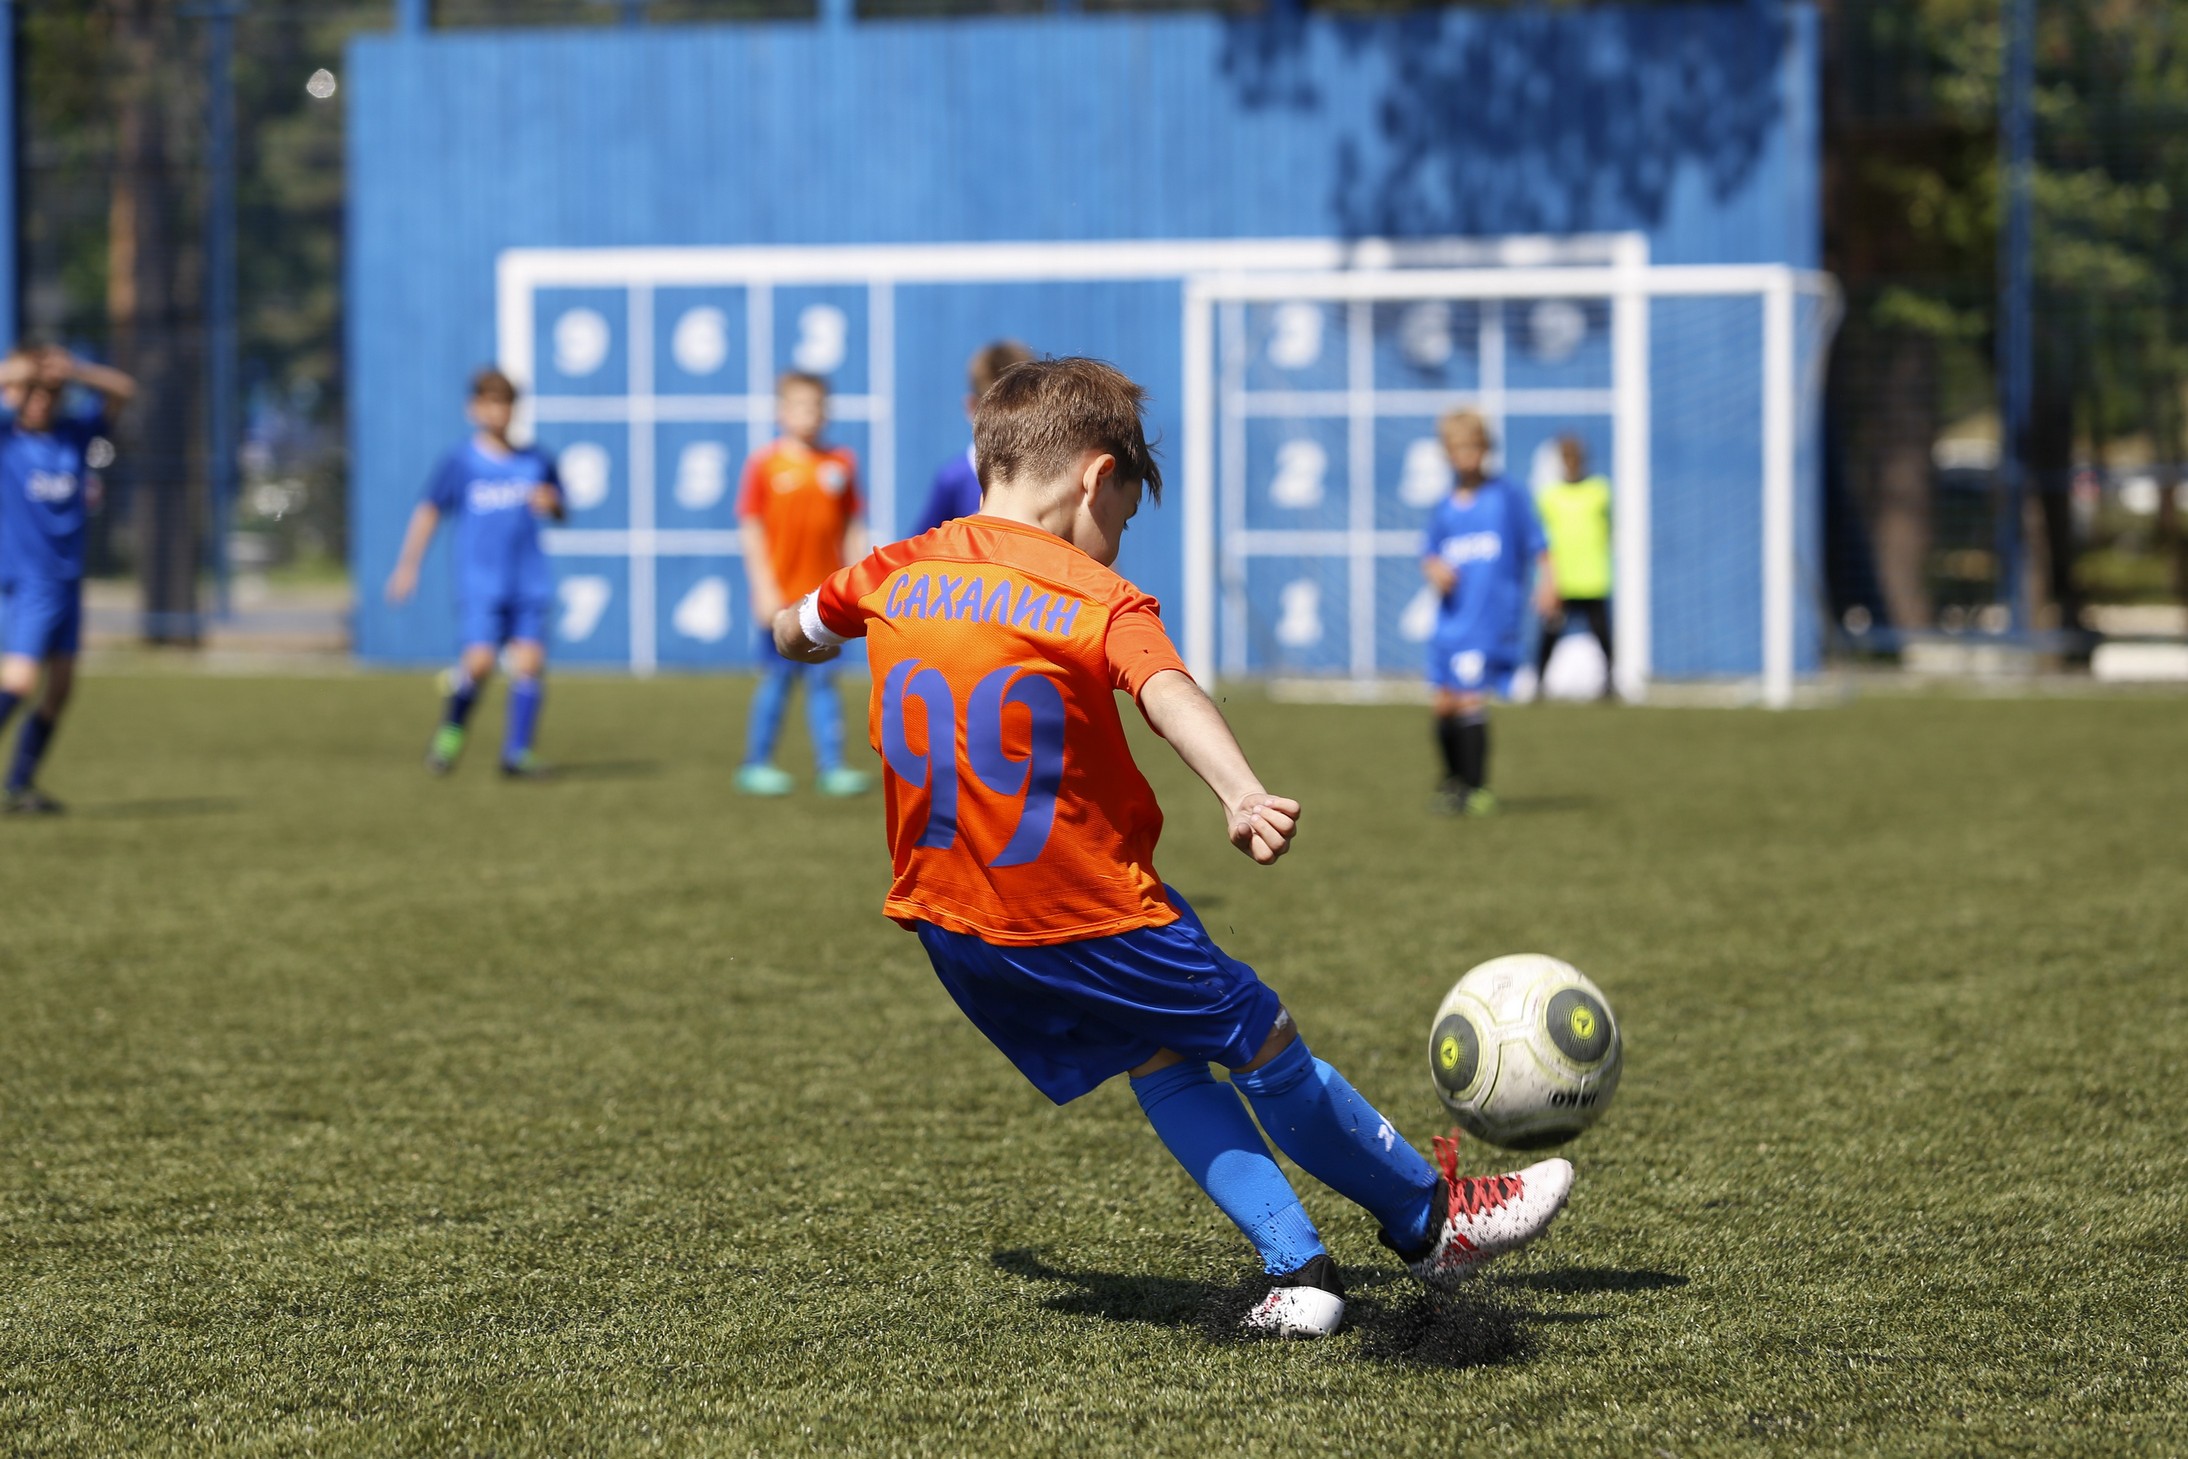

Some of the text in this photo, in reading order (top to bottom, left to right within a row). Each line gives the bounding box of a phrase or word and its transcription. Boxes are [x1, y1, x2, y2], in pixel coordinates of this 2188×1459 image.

[553, 304, 849, 378] 9 6 3
[1267, 302, 1324, 368] 3
[1269, 438, 1327, 509] 2
[556, 574, 731, 643] 7 4
[885, 573, 1082, 637] САХАЛИН
[1274, 577, 1324, 648] 1
[881, 658, 1066, 869] 99
